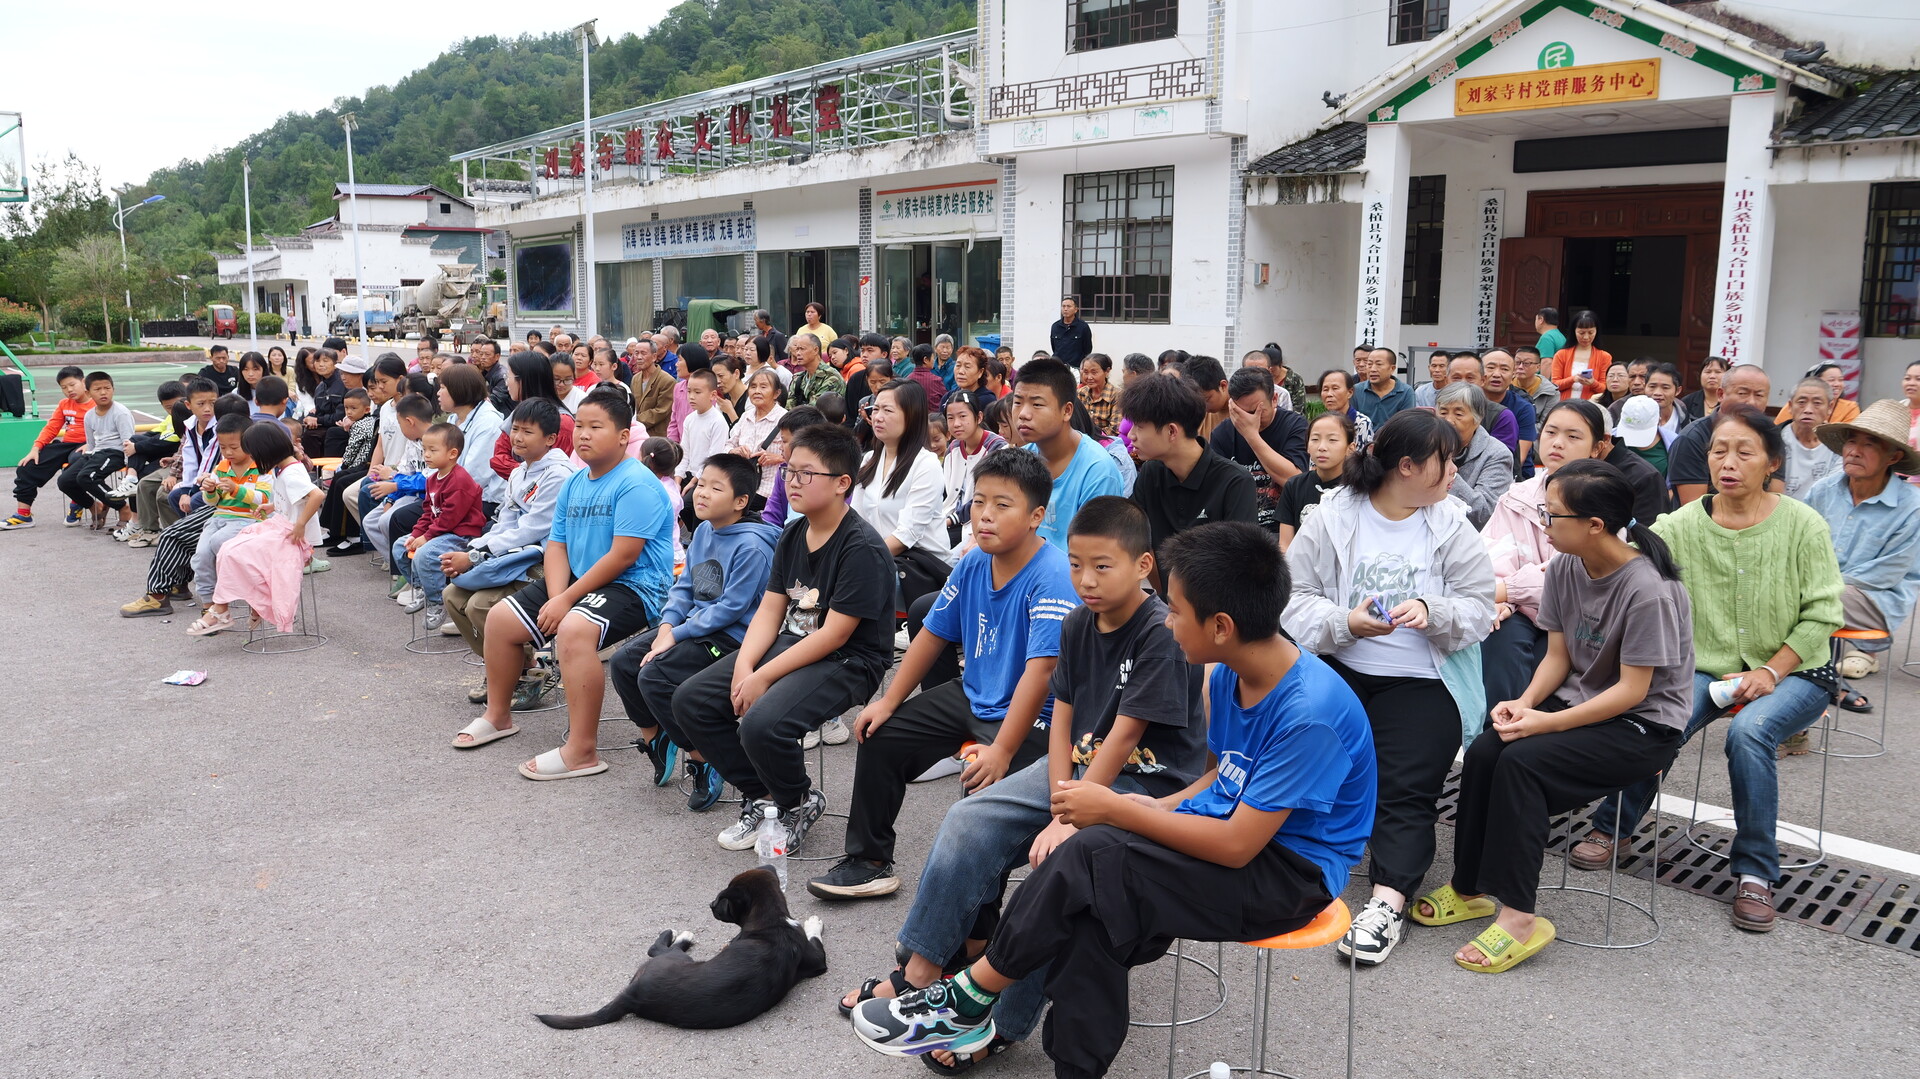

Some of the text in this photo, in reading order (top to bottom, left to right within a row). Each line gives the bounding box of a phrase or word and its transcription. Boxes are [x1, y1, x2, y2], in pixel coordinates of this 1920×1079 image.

[1467, 72, 1645, 104] 刘家寺村党群服务中心
[897, 190, 994, 219] 刘家寺供销惠农综合服务社
